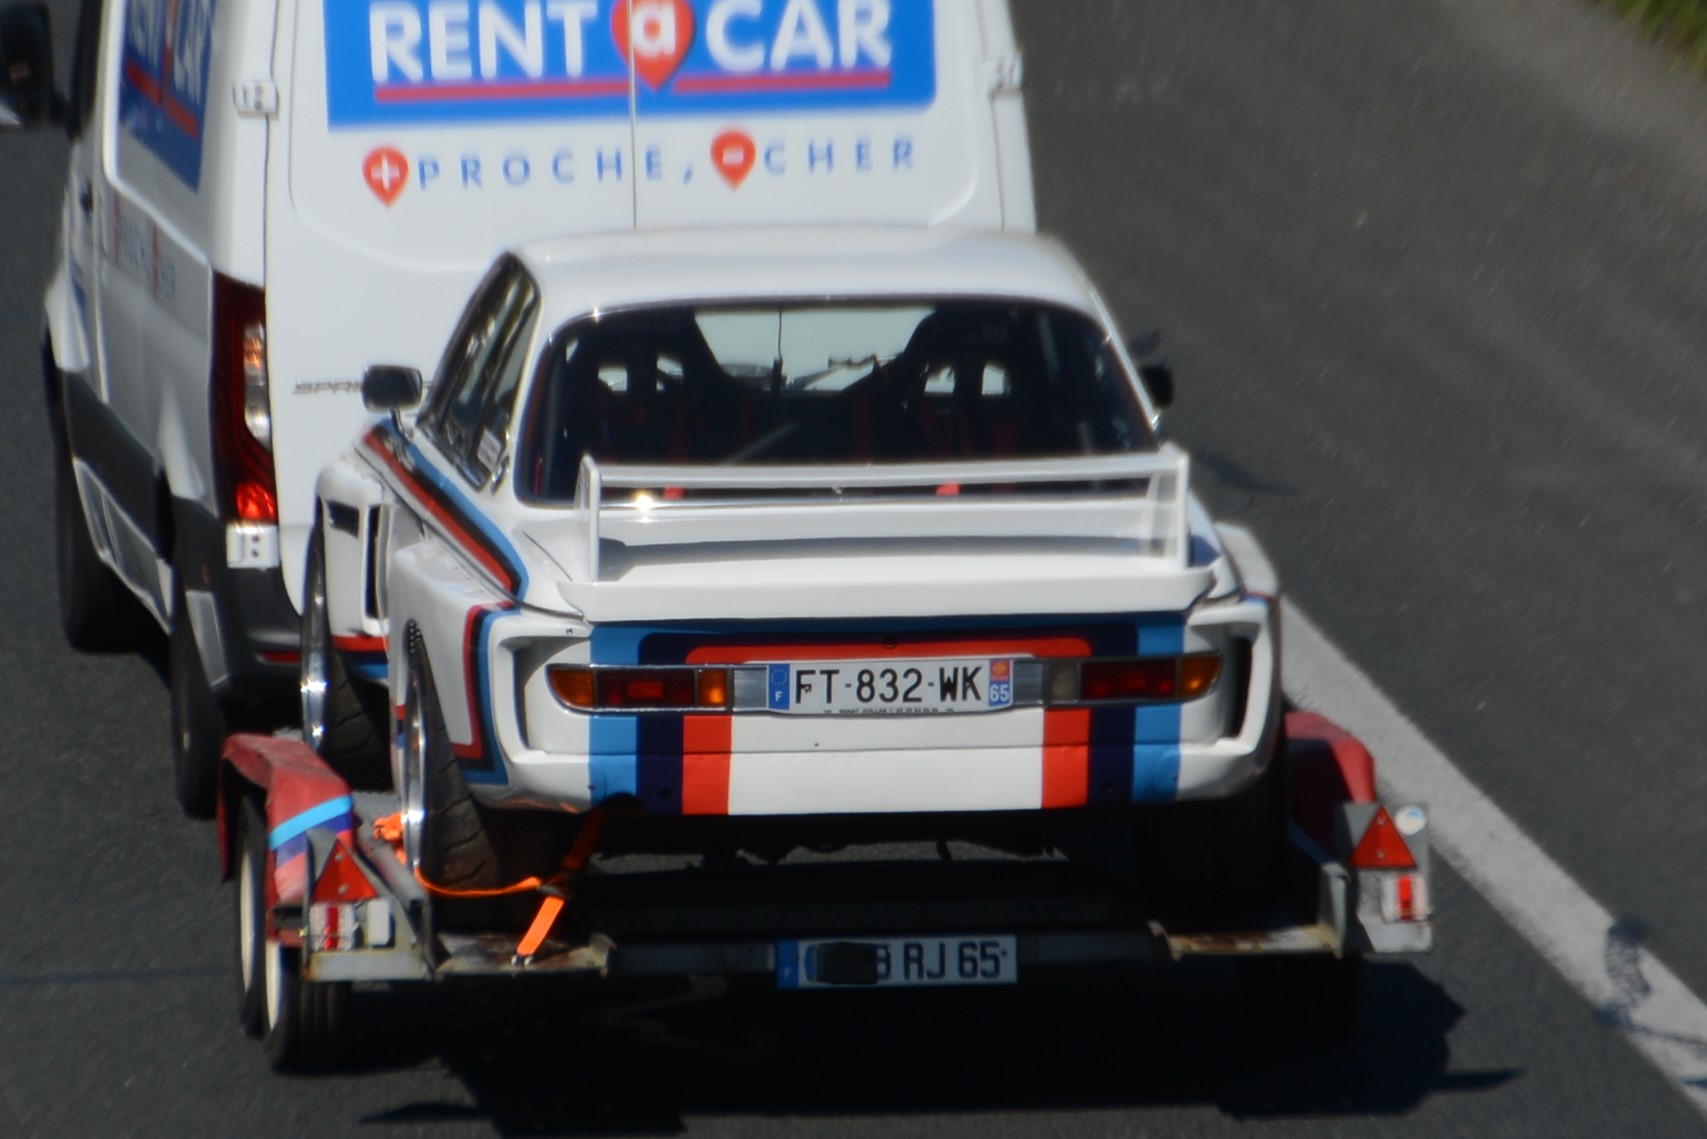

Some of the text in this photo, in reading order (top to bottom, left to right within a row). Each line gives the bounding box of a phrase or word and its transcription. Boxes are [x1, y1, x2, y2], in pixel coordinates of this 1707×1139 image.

[369, 0, 598, 82] RENT
[706, 0, 892, 73] CAR
[763, 135, 914, 174] CHER
[774, 665, 1010, 704] F FT-832-WK 65
[903, 941, 947, 981] RJ
[957, 940, 1001, 980] 65
